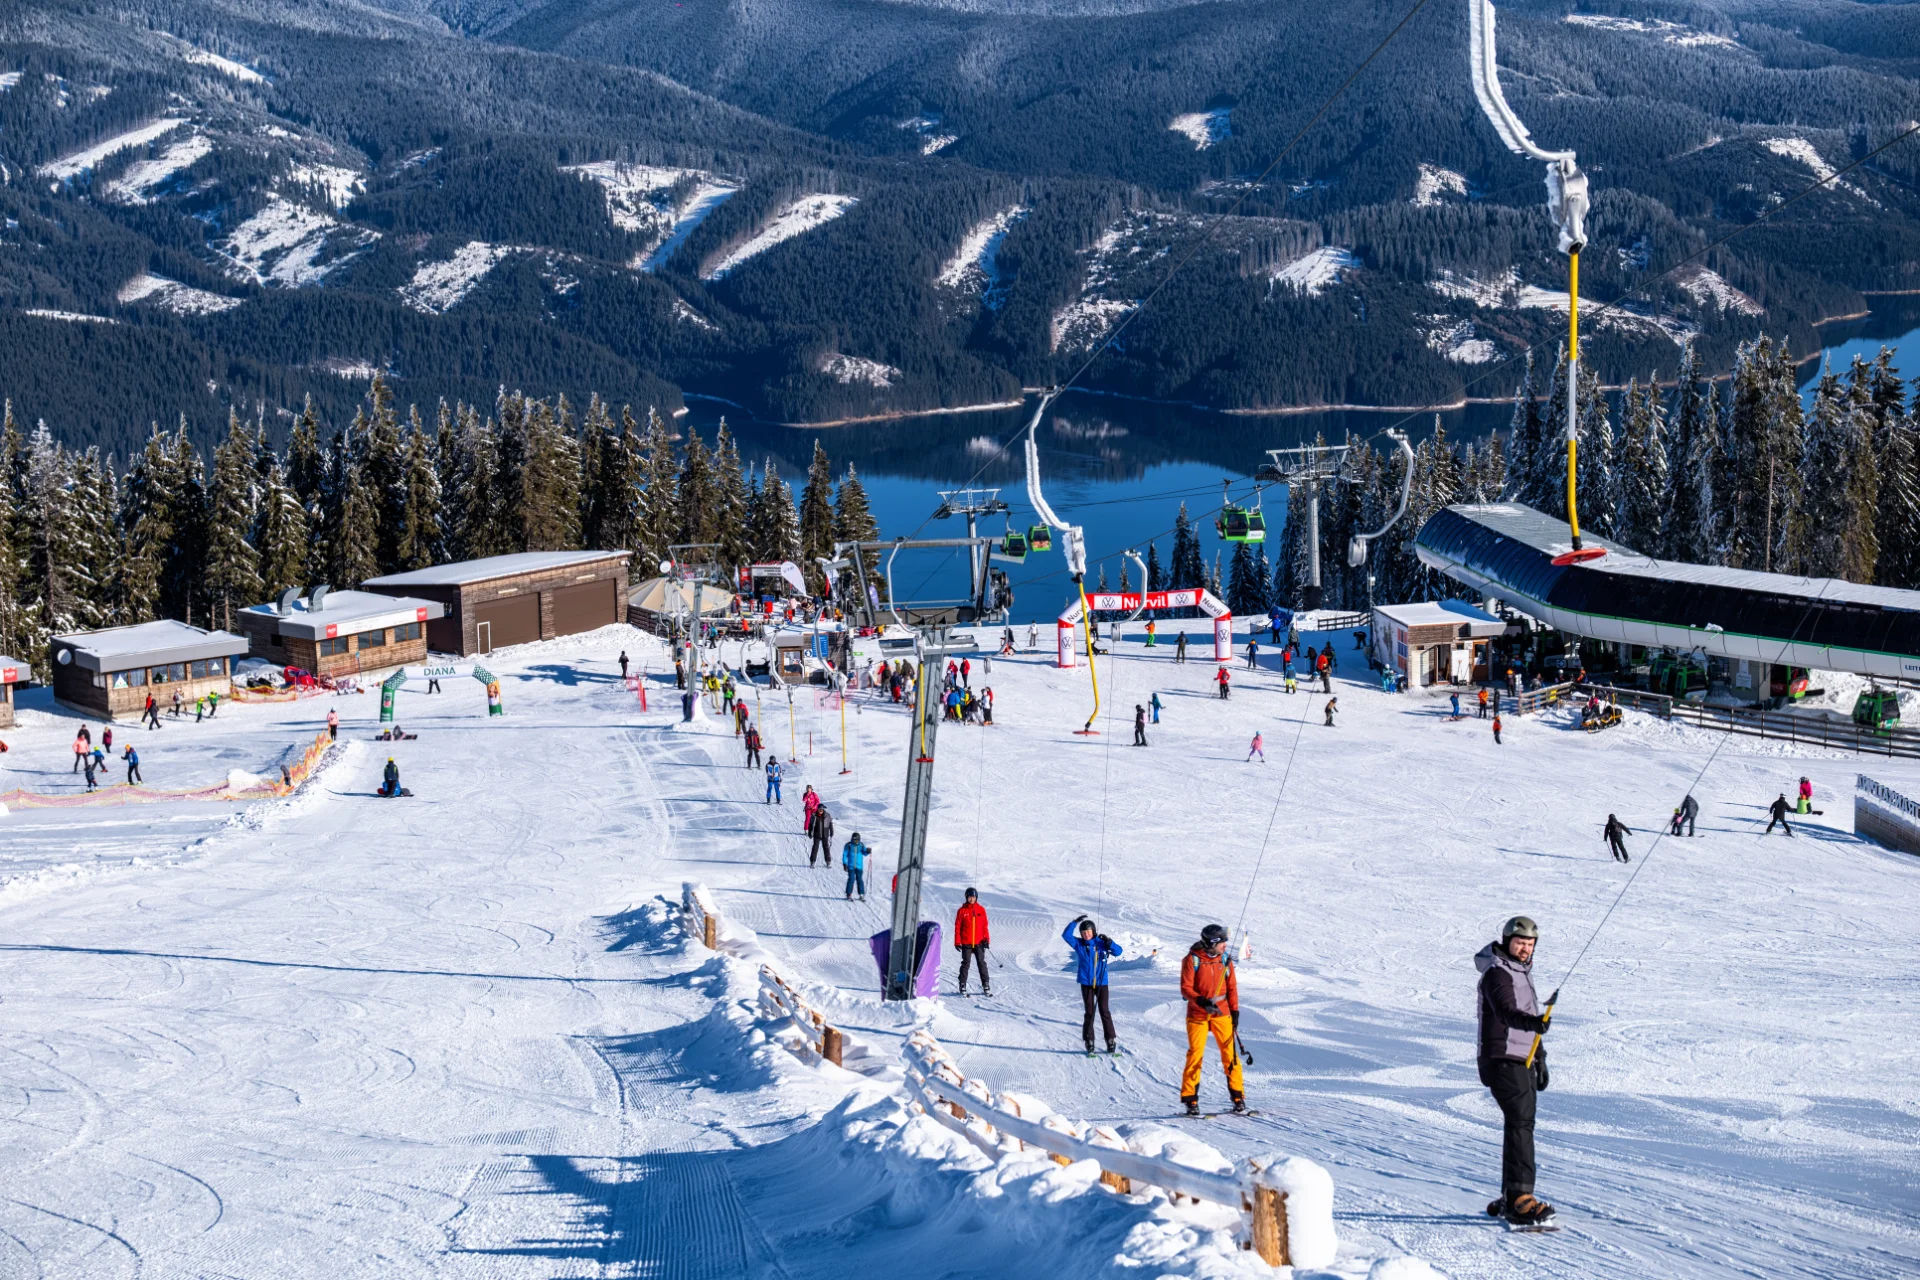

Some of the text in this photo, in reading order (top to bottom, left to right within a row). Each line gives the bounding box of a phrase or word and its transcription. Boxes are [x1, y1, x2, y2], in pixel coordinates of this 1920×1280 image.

[1124, 595, 1166, 608] Nurvil
[1202, 597, 1223, 615] Nurvil
[423, 667, 456, 676] DIANA
[1904, 664, 1920, 672] LEIT
